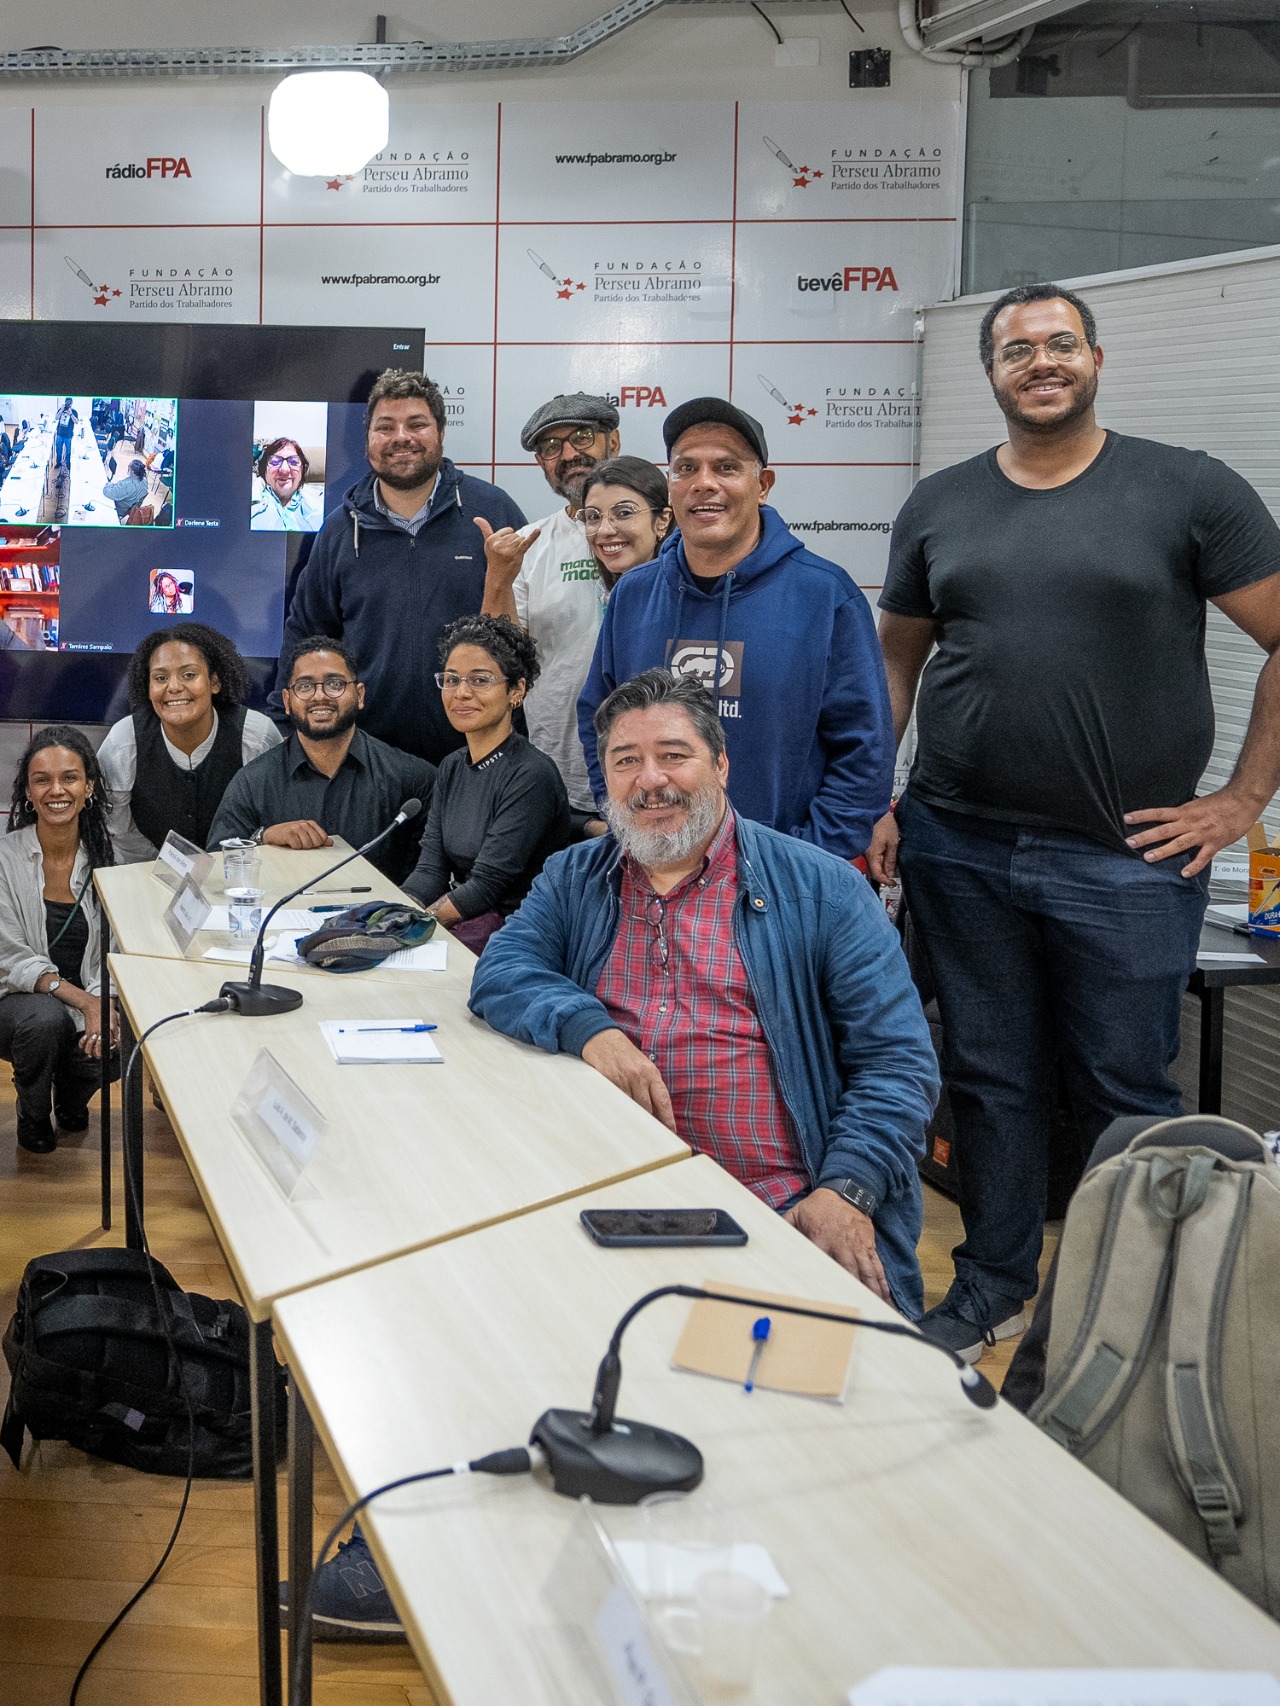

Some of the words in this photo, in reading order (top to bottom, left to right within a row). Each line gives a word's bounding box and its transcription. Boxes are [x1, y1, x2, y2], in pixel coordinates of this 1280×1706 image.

[375, 151, 469, 162] UNDAÇÃO
[555, 151, 677, 166] www.fpabramo.org.br
[831, 148, 942, 160] FUNDAÇÃO
[106, 157, 191, 179] rádioFPA
[364, 167, 408, 181] Perseu
[413, 167, 469, 181] Abramo
[832, 164, 879, 178] Perseu
[882, 164, 941, 178] Abramo
[363, 184, 392, 193] Partido
[394, 184, 408, 192] dos
[410, 184, 468, 193] Trabalhadores
[830, 181, 861, 190] Partido
[863, 181, 878, 190] dos
[880, 181, 941, 190] Trabalhadores
[130, 267, 233, 279] FUNDAÇÃO
[594, 261, 702, 273] FUNDAÇÃO
[321, 273, 441, 288] www.fpabramo.org.br
[594, 276, 640, 290] Perseu
[645, 277, 702, 290] Abramo
[797, 266, 899, 292] tevêFPA
[130, 282, 174, 297] Perseu
[178, 283, 233, 297] Abramo
[593, 294, 624, 302] Partido
[626, 294, 639, 302] dos
[641, 294, 701, 302] Trabalhadores
[129, 300, 157, 309] Partido
[160, 300, 175, 308] dos
[176, 300, 233, 308] Trabalhadores
[393, 343, 411, 351] Entrar
[825, 387, 919, 397] FUNDAÇ
[826, 402, 872, 416] Perseu
[825, 419, 855, 428] Partido
[857, 419, 872, 428] dos
[184, 519, 203, 527] Darlene
[69, 643, 88, 651] Tamires
[88, 644, 113, 652] Sampaio
